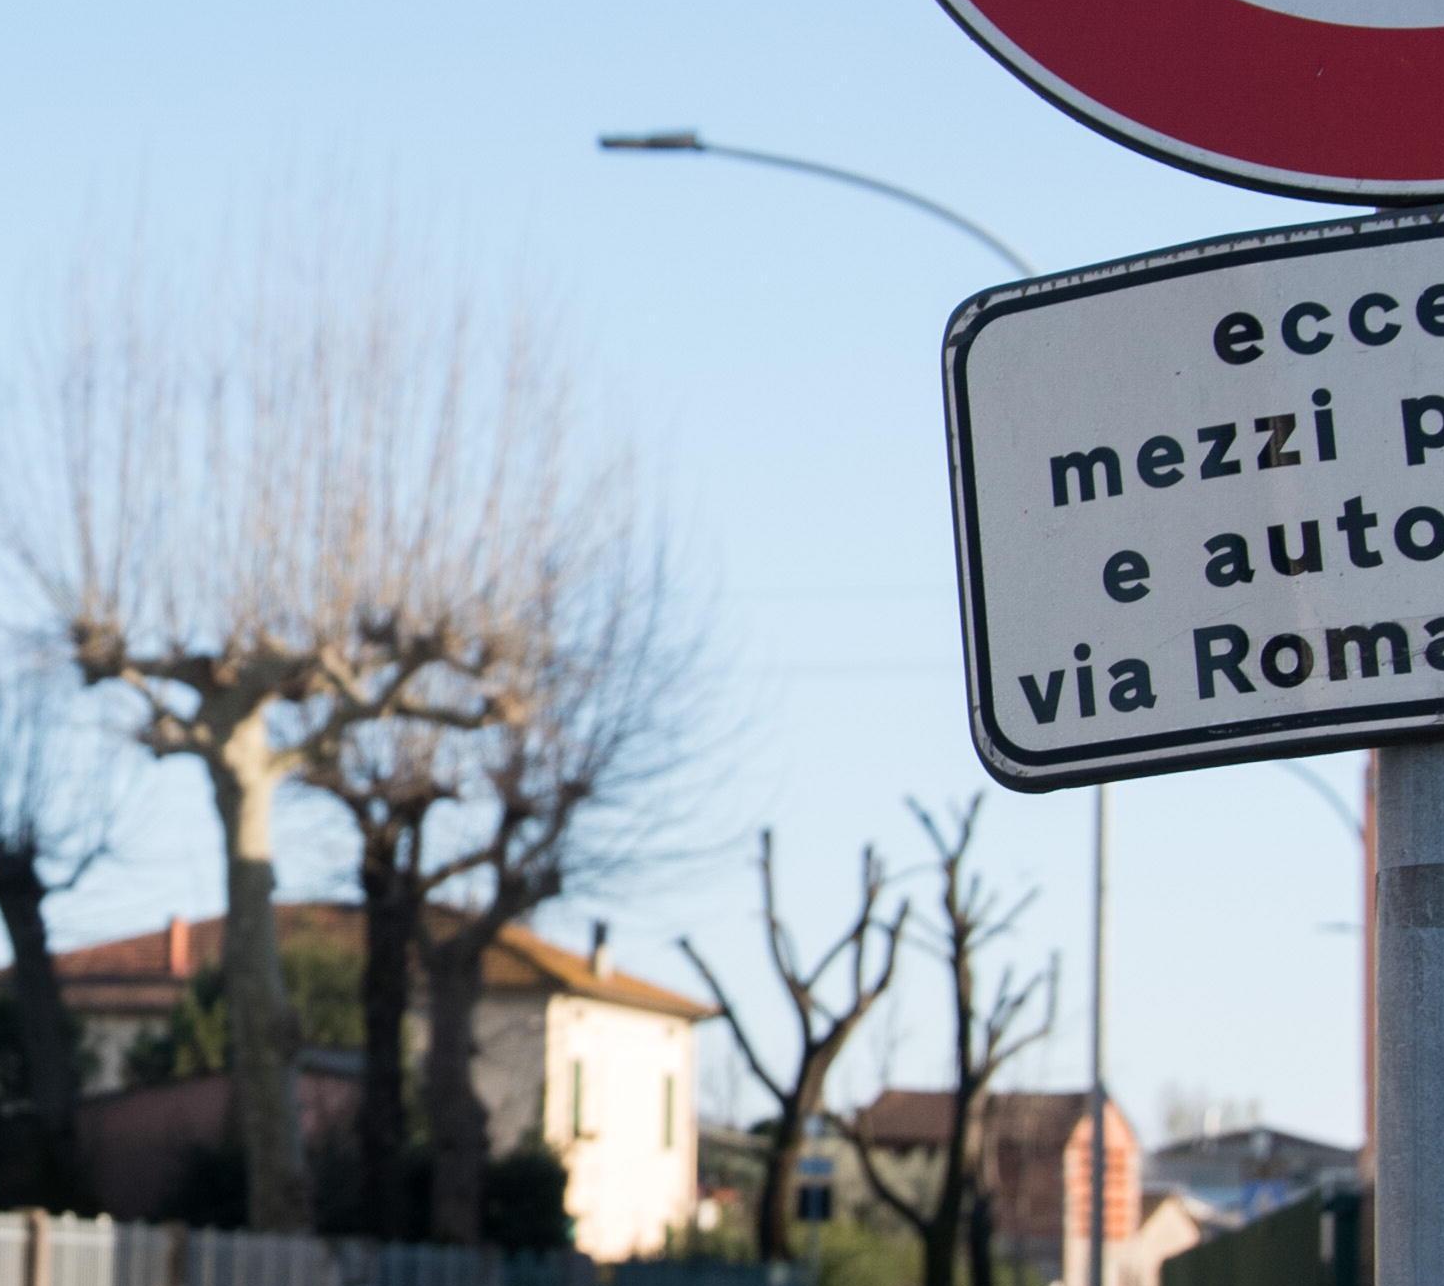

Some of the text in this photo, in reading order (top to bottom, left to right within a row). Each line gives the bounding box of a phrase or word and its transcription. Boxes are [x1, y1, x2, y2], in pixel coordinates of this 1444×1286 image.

[1049, 387, 1337, 508] mezzi
[1102, 549, 1151, 604] e
[1017, 642, 1158, 725] via
